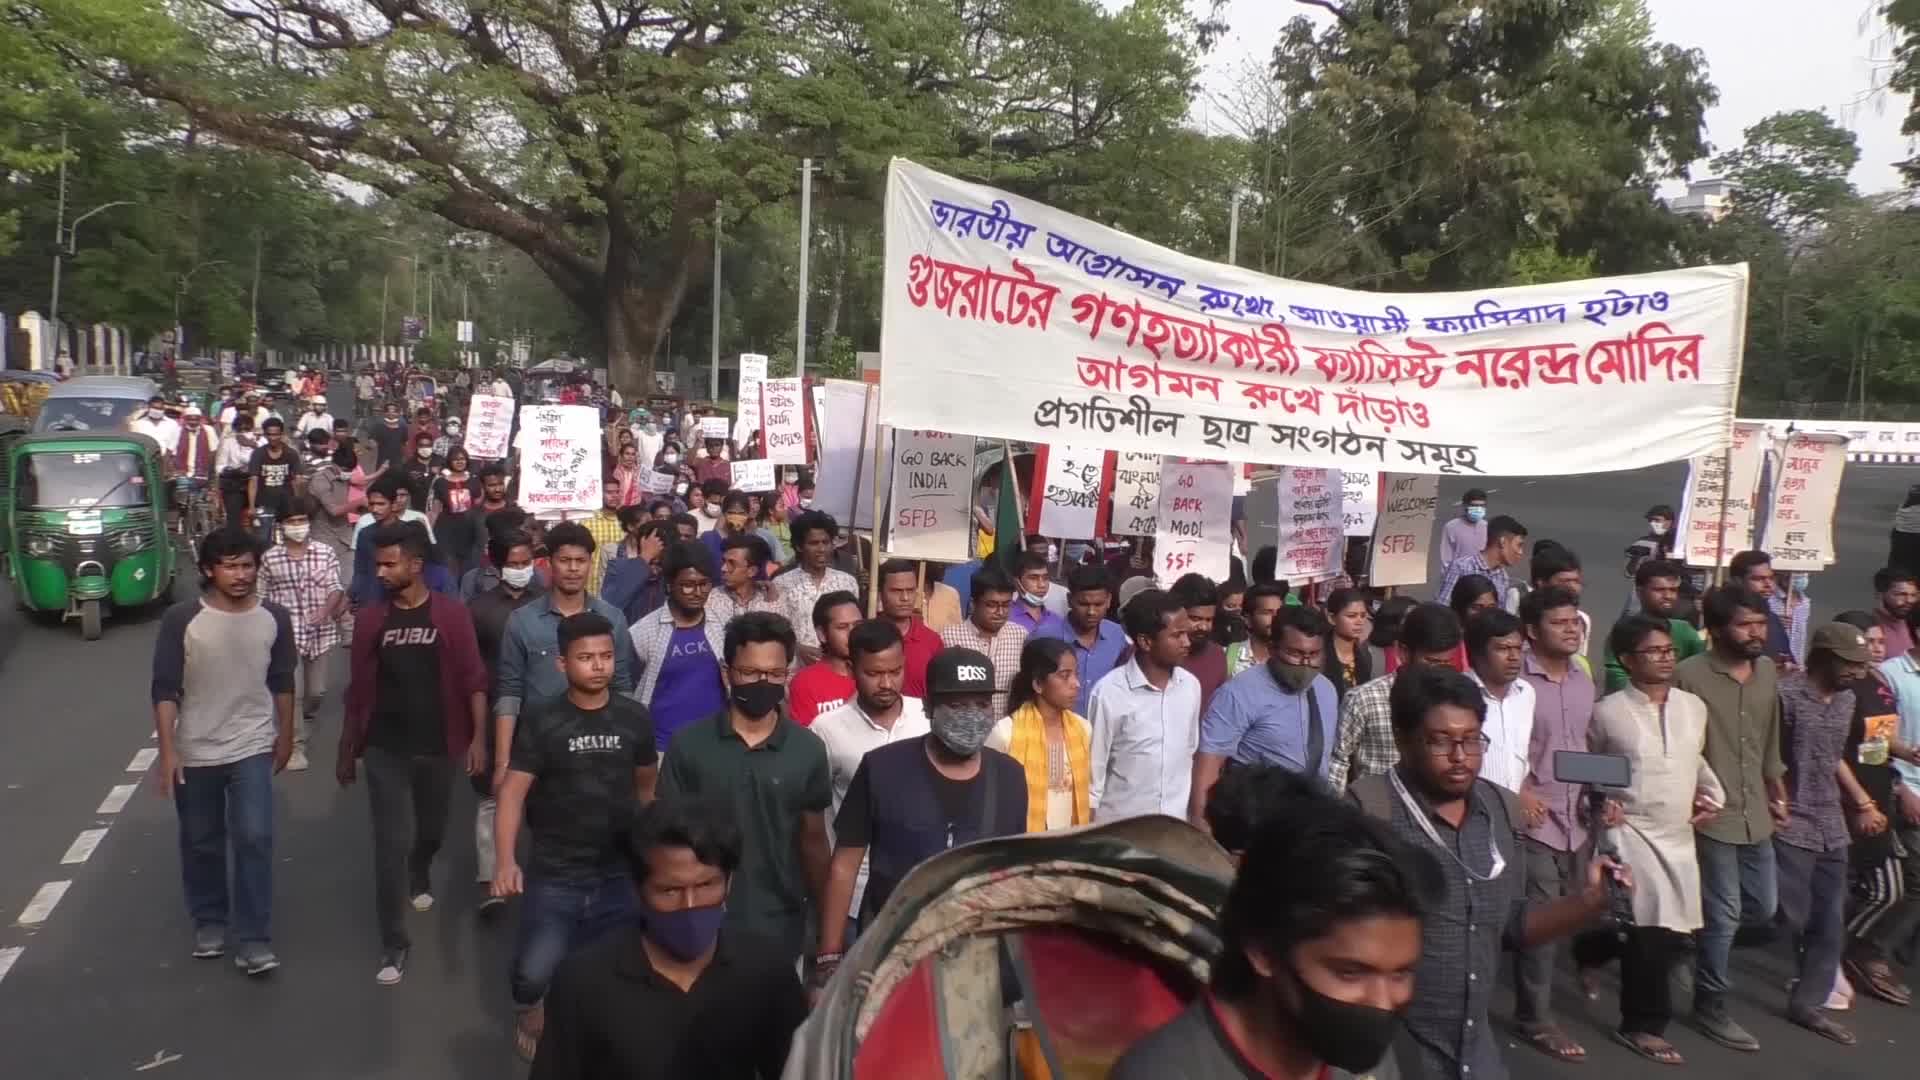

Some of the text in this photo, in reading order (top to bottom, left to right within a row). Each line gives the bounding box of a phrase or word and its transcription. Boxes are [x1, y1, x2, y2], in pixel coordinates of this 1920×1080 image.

[930, 200, 1037, 250] ভারতীয়
[1047, 231, 1185, 297] আগ্রাসন
[1289, 305, 1411, 335] আওয়ামী
[1424, 299, 1566, 334] ফ্যাসিবাদ
[1581, 289, 1670, 326] হটাও
[907, 253, 1705, 390] গুজরাটের গণহত্যাকারী ফ্যাসিস্ট নরেন্দ্র মোদির
[1077, 355, 1430, 433] আগমন রুখে দাঁড়াও
[1034, 394, 1488, 474] প্রগতিশীল ছাত্র সংগঠন সমূহ
[901, 449, 967, 467] GO BACK
[909, 472, 948, 489] INDIA
[1178, 475, 1193, 488] GO
[1393, 477, 1418, 493] NOT
[1172, 498, 1202, 513] BACK
[1387, 497, 1438, 513] WELCOME
[899, 508, 937, 528] SFB
[1382, 534, 1416, 554] SFB
[1166, 552, 1196, 571] SSF
[383, 627, 438, 647] FUBU
[957, 665, 987, 681] BOSS
[568, 735, 622, 752] BREATHE
